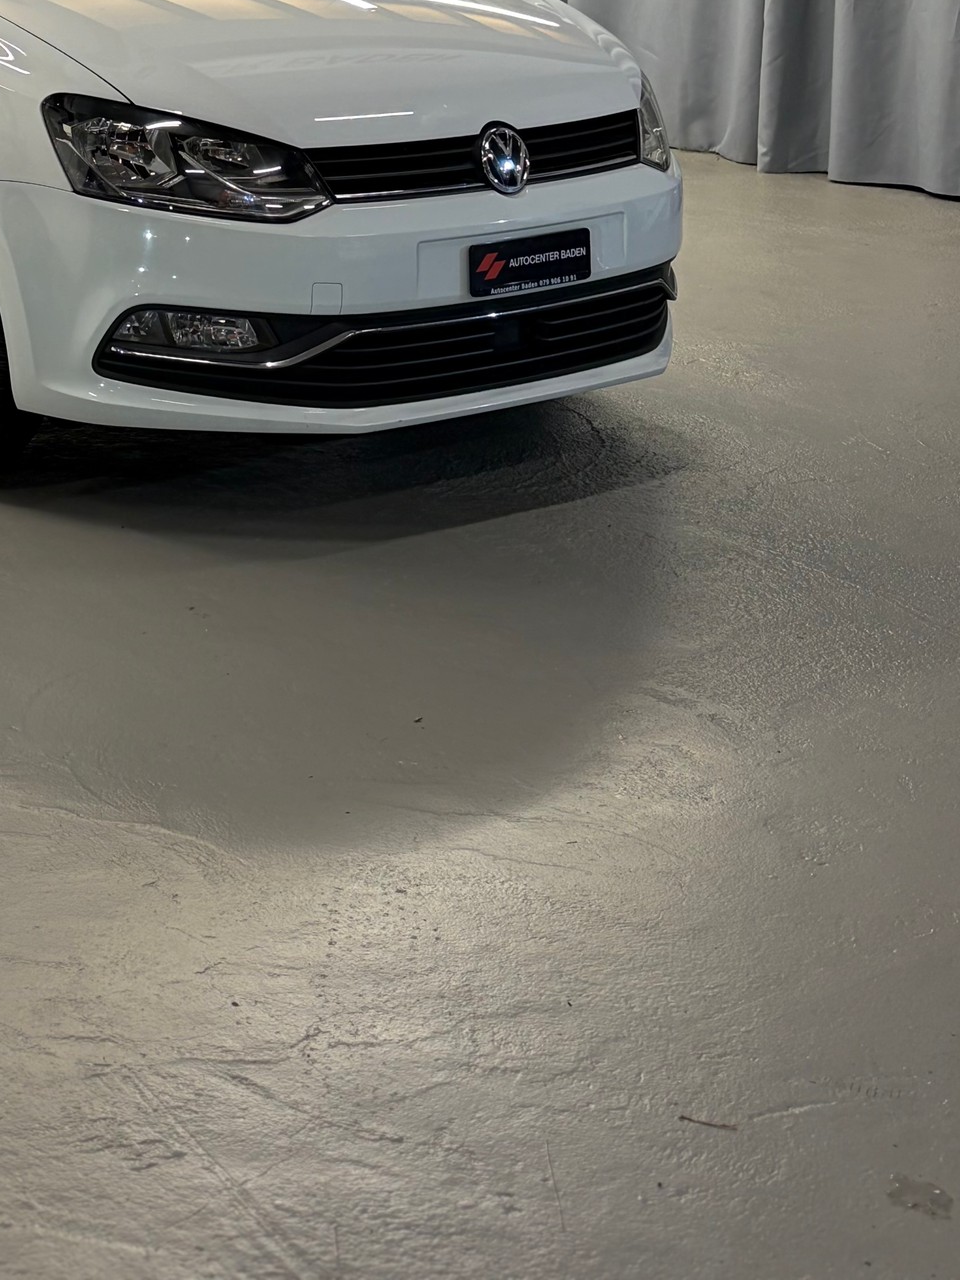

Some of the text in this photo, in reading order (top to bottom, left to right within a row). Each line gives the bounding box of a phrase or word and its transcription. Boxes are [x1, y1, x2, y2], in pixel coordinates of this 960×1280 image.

[509, 247, 586, 268] AUTOCENTER BADEN
[490, 283, 520, 295] Autocenter
[521, 281, 538, 290] Baden
